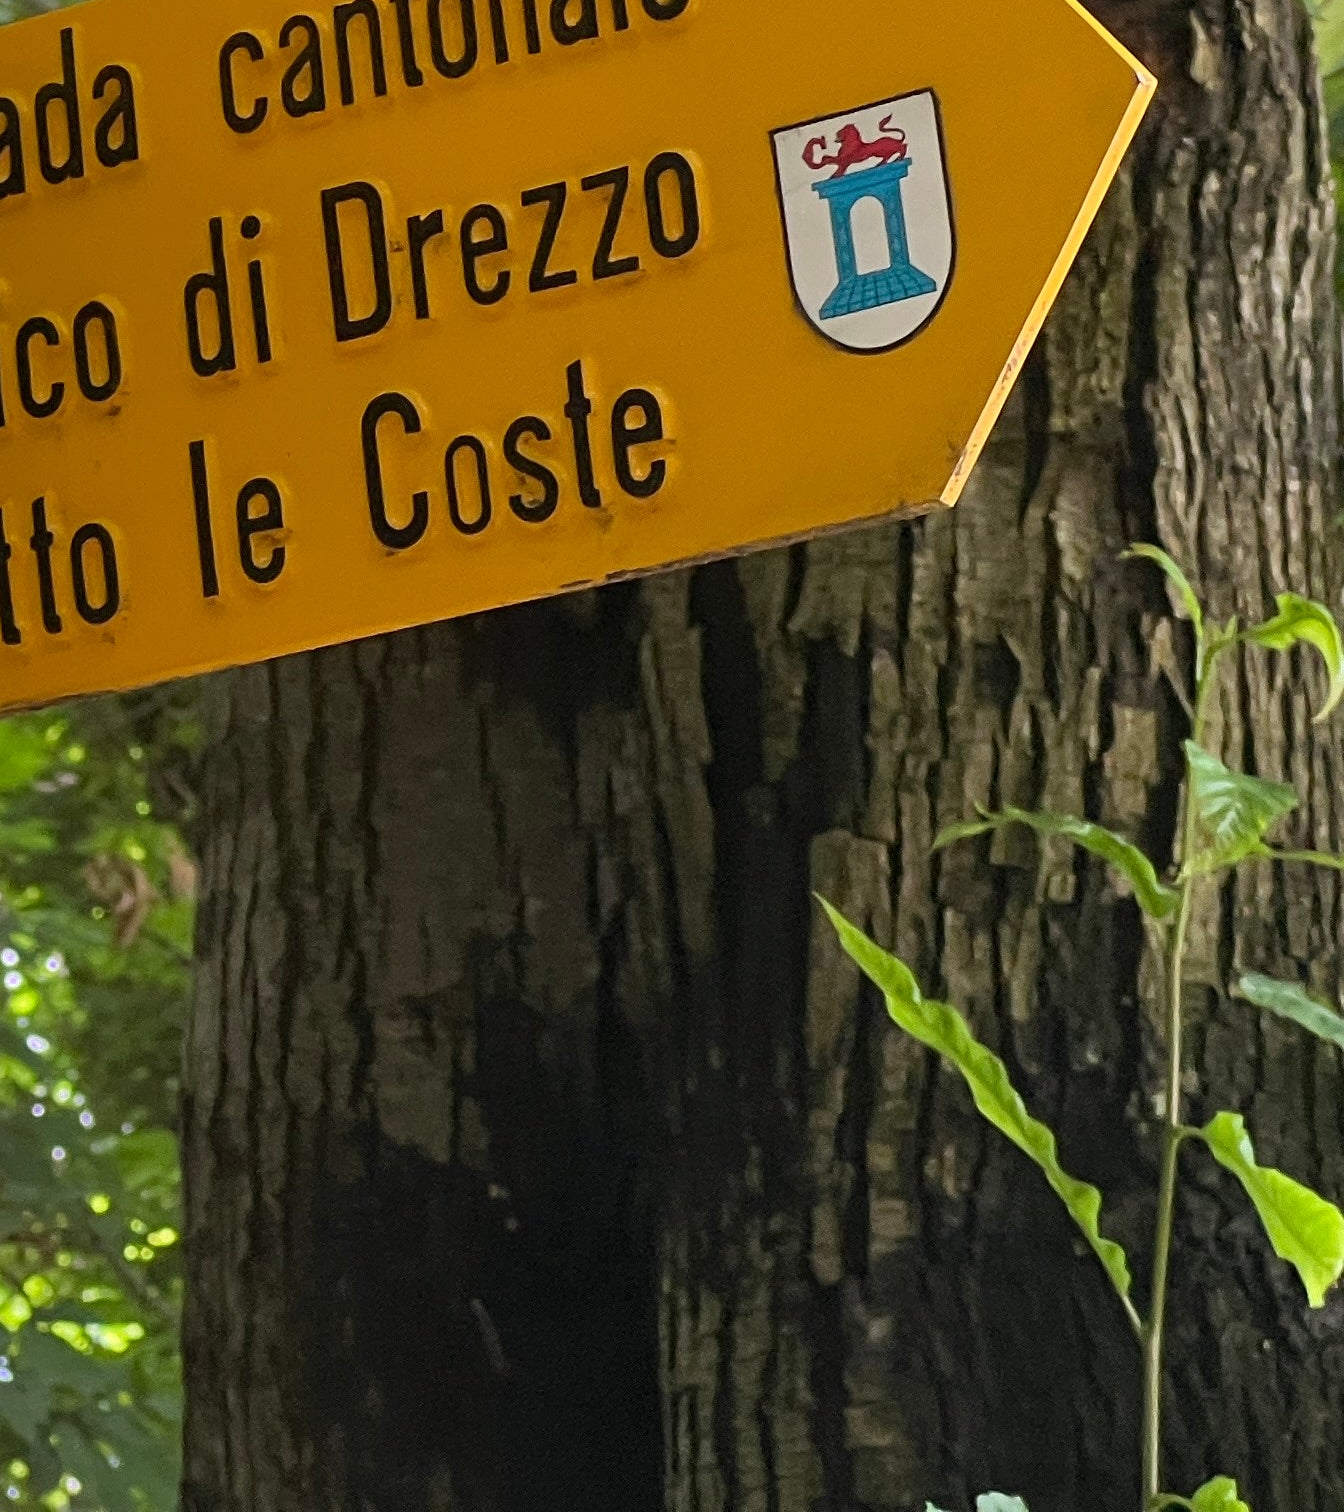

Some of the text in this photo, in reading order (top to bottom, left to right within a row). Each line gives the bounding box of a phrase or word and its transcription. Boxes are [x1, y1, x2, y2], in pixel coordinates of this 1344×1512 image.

[184, 215, 271, 378] di
[321, 151, 701, 342] Drezzo
[189, 439, 287, 598] le
[360, 359, 667, 550] Coste
